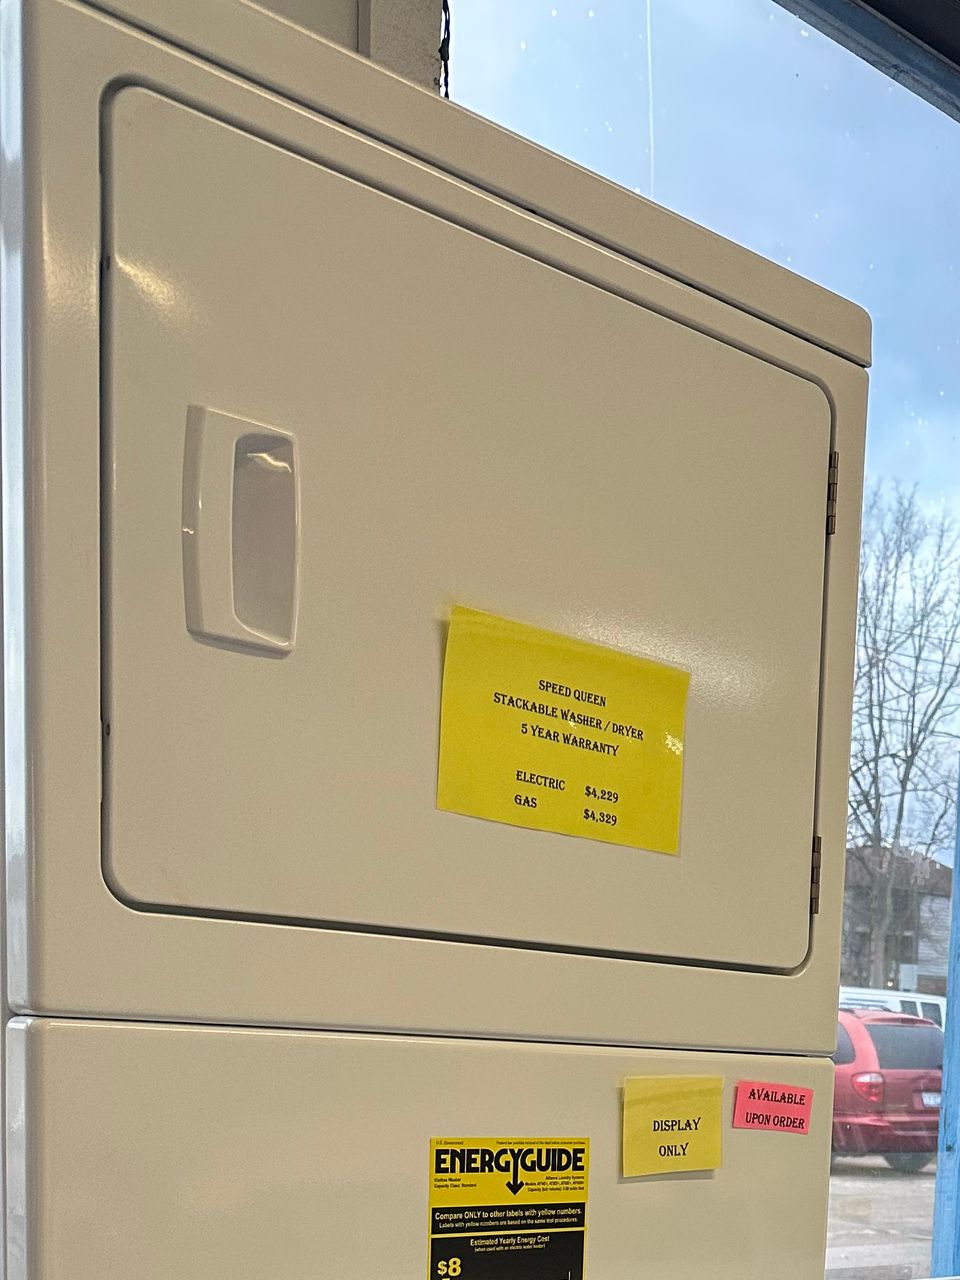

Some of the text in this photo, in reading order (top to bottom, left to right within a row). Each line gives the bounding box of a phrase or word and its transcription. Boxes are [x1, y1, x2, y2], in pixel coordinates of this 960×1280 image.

[539, 680, 606, 707] SPEED QUEEN
[494, 692, 557, 718] STACKABLE
[561, 709, 601, 729] WASHER
[612, 723, 643, 740] DRYER
[521, 724, 619, 756] 5 YEAR WARRANTY
[516, 770, 618, 803] ELECTRIC $4,229
[514, 795, 617, 825] GAS $4,329
[748, 1088, 805, 1105] AVAILABLE
[653, 1117, 701, 1131] DISPLAY
[745, 1112, 805, 1129] UPON ORDER
[659, 1143, 689, 1156] ONLY
[435, 1148, 585, 1174] ENERGYGUIDE
[435, 1212, 462, 1220] Compare
[465, 1211, 480, 1219] ONLY
[538, 1208, 555, 1217] yellow
[499, 1237, 516, 1246] Yearly
[517, 1237, 536, 1245] Energy
[437, 1257, 461, 1276] $8
